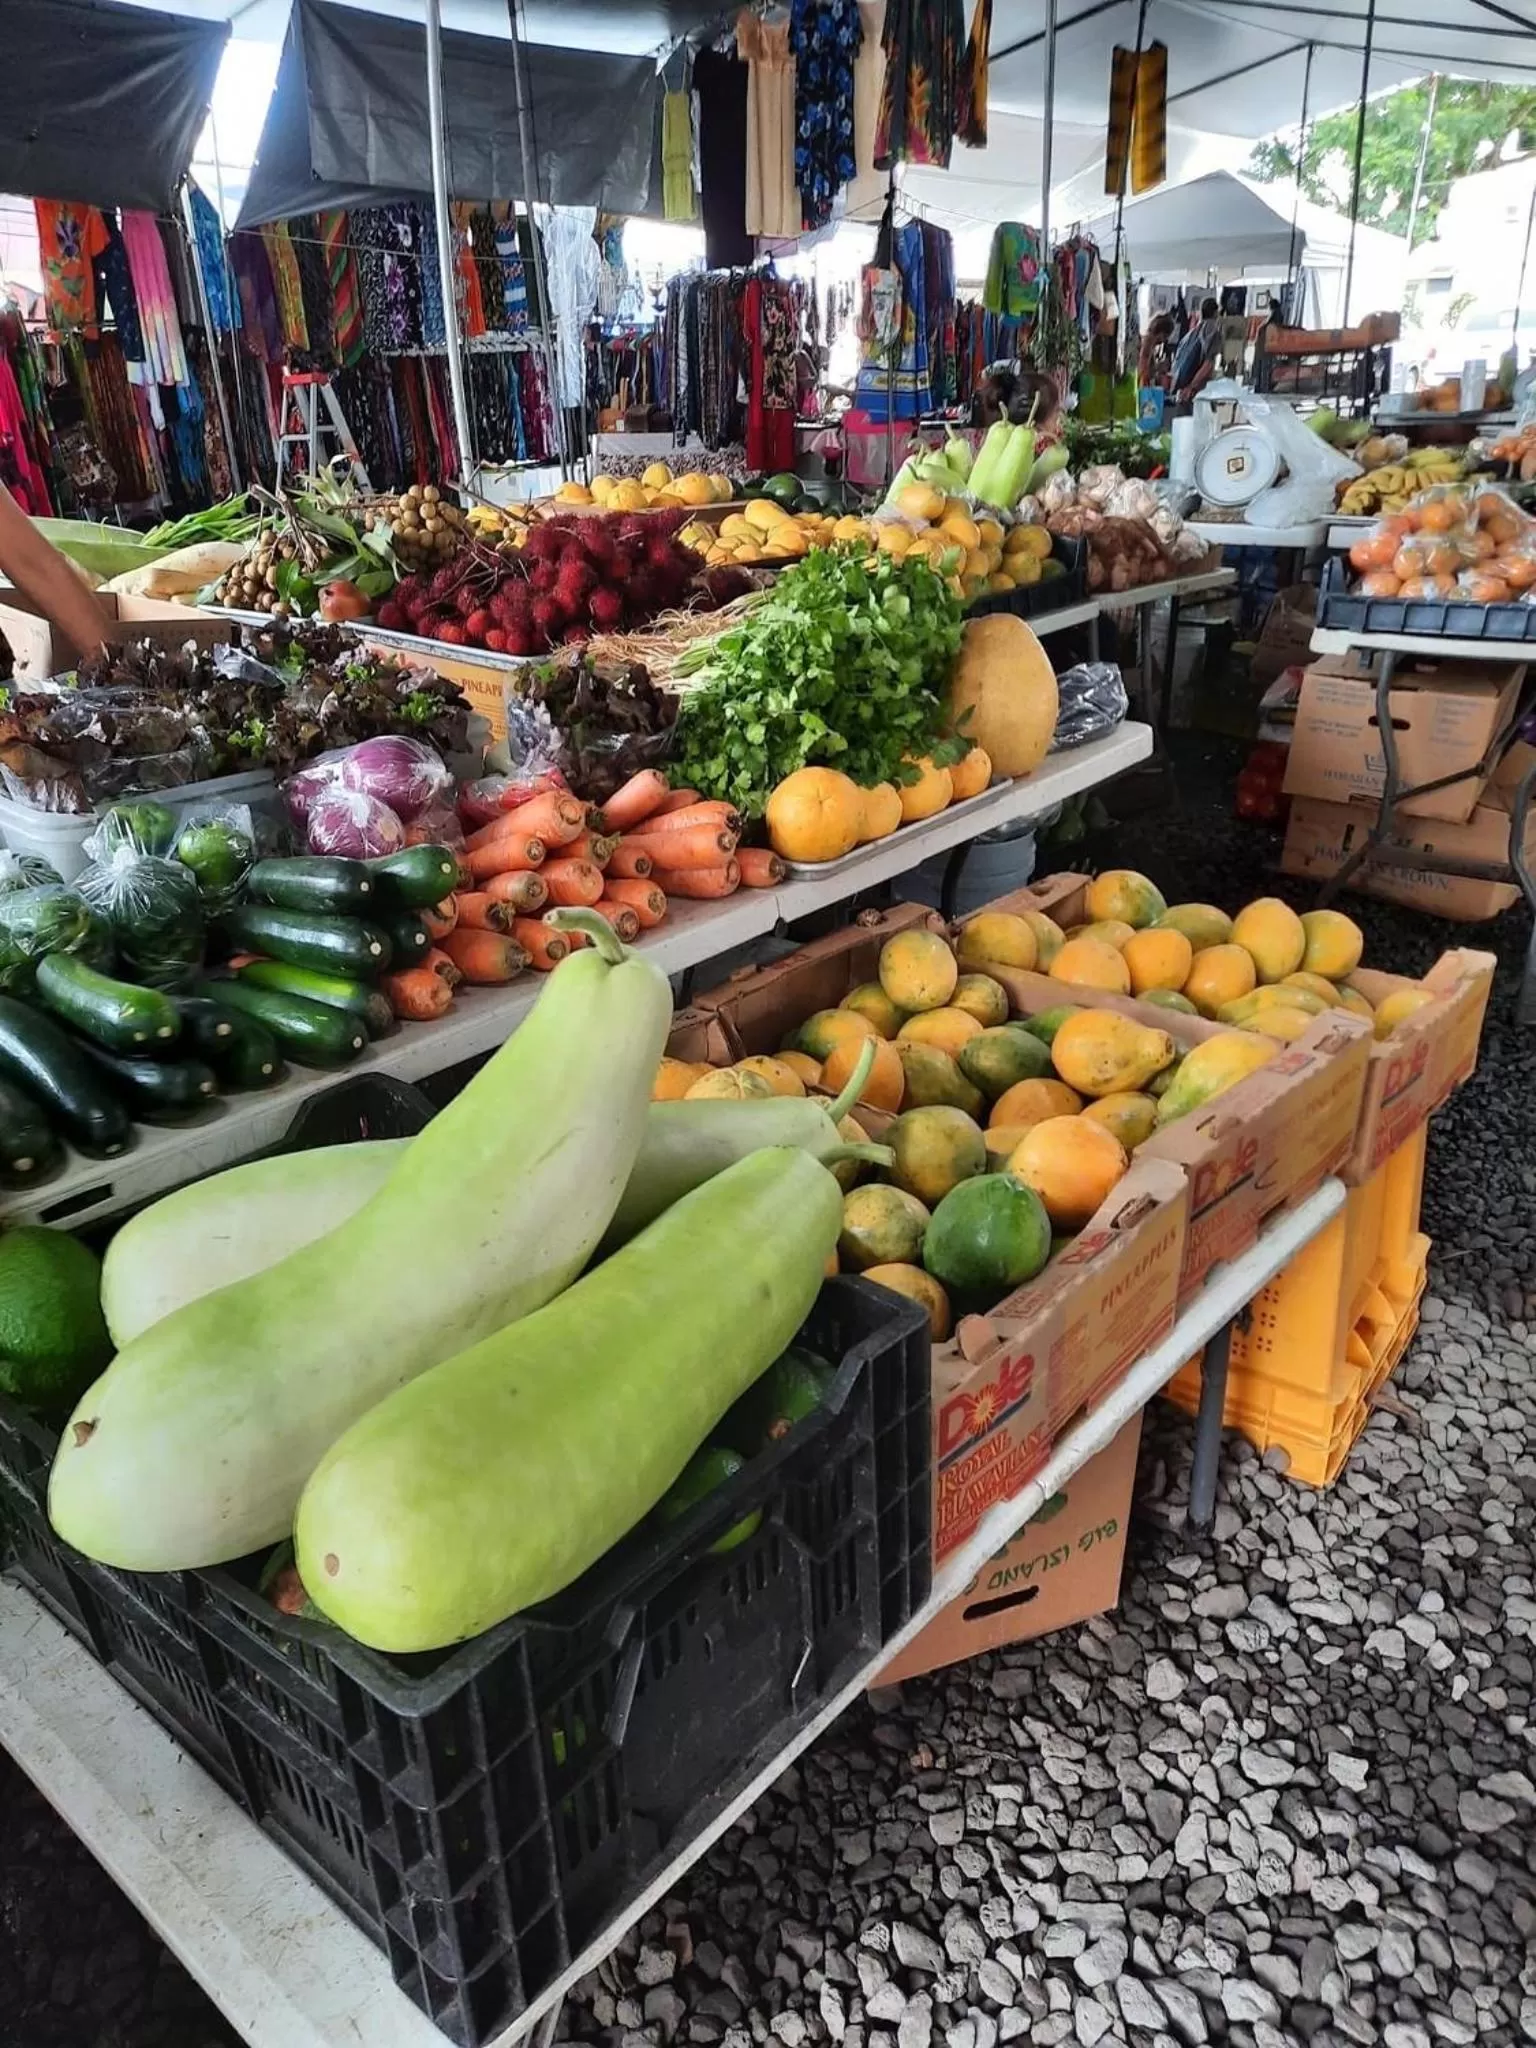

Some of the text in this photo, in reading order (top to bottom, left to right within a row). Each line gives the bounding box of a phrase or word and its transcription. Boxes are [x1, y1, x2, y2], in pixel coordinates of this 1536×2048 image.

[1192, 1136, 1258, 1207] Dole
[1101, 1226, 1177, 1314] PINEAPPLES
[939, 1354, 1035, 1458] Dole
[987, 1544, 1071, 1591] ISLAND
[1078, 1518, 1118, 1553] BIG
